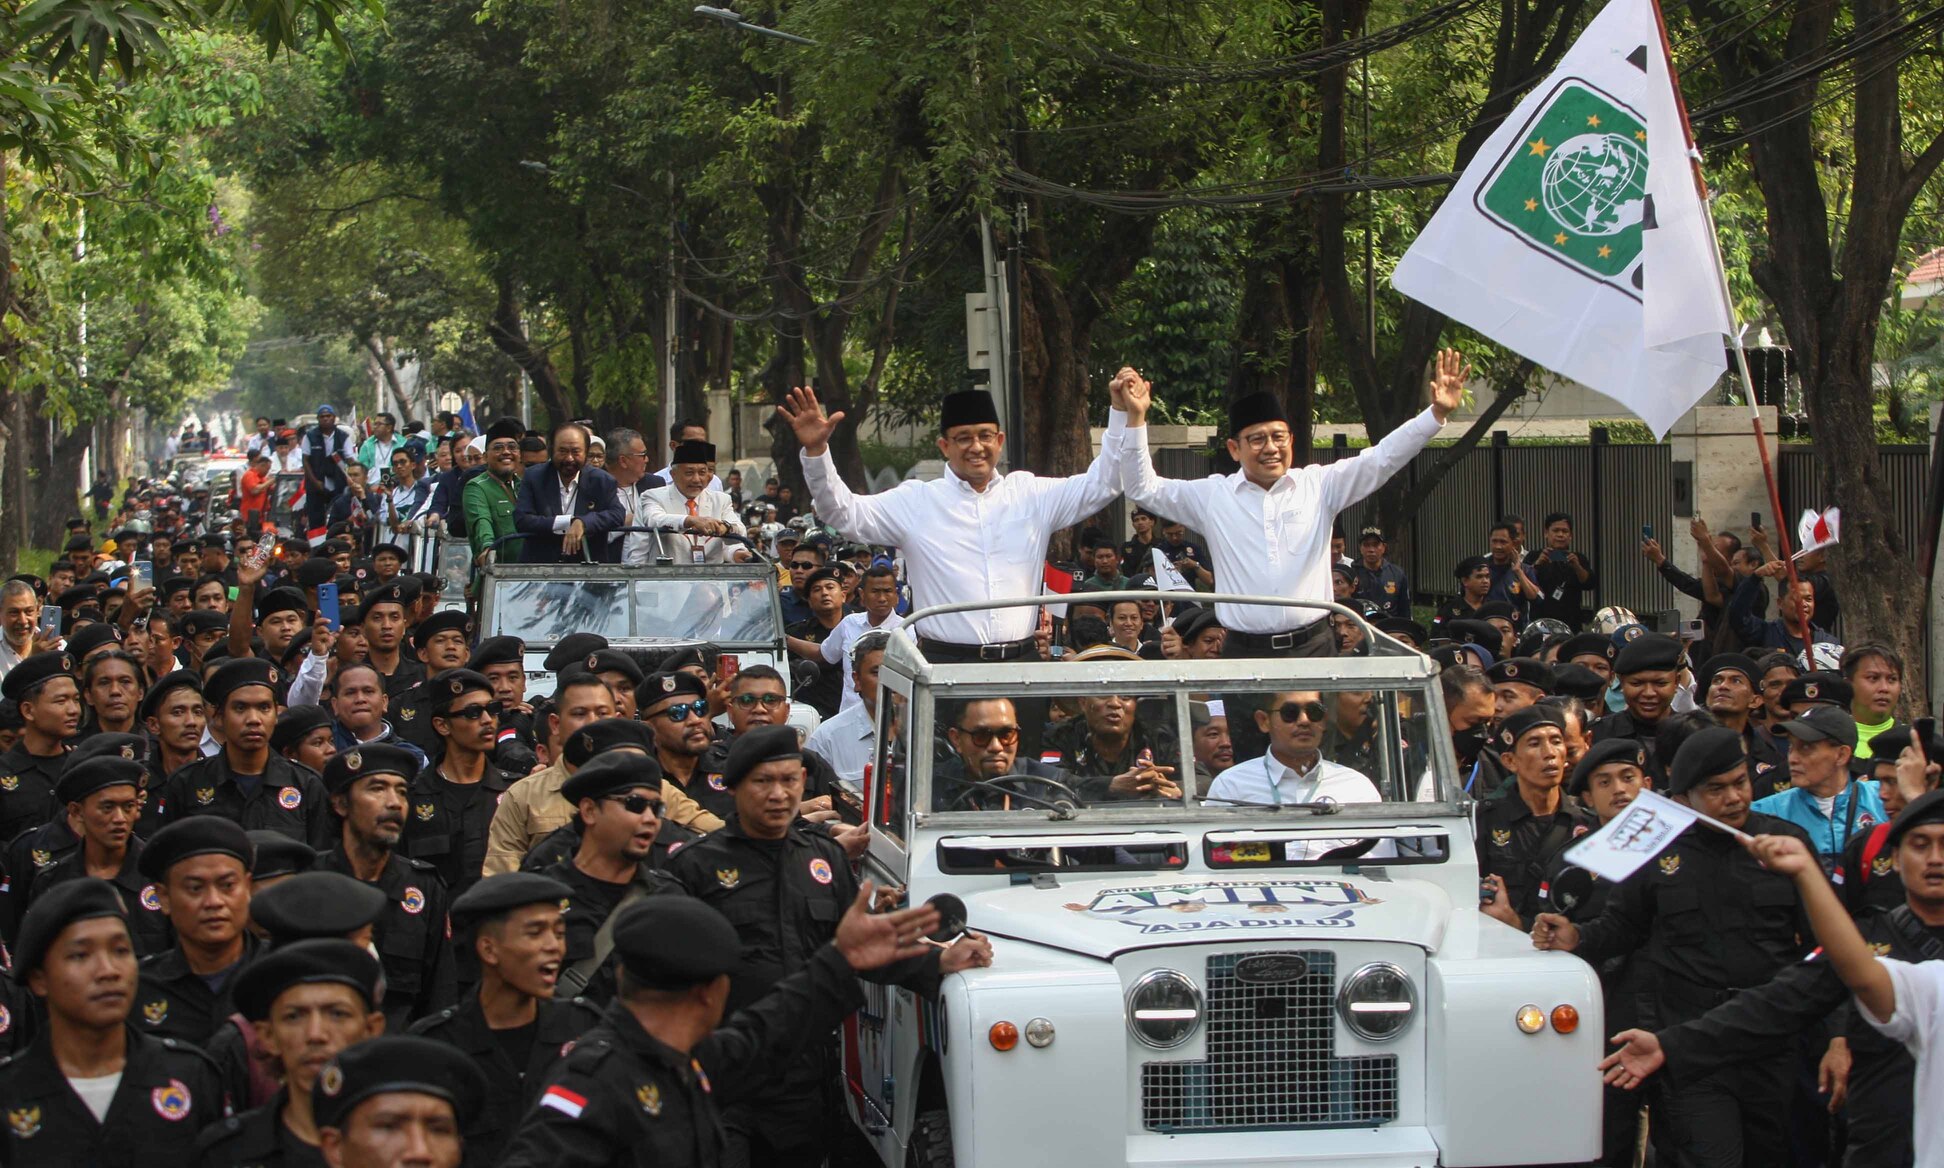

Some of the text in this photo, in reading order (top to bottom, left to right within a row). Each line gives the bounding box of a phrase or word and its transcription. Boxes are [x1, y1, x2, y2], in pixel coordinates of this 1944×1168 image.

[1091, 885, 1353, 911] AMIN
[1148, 918, 1340, 933] AJA DULU
